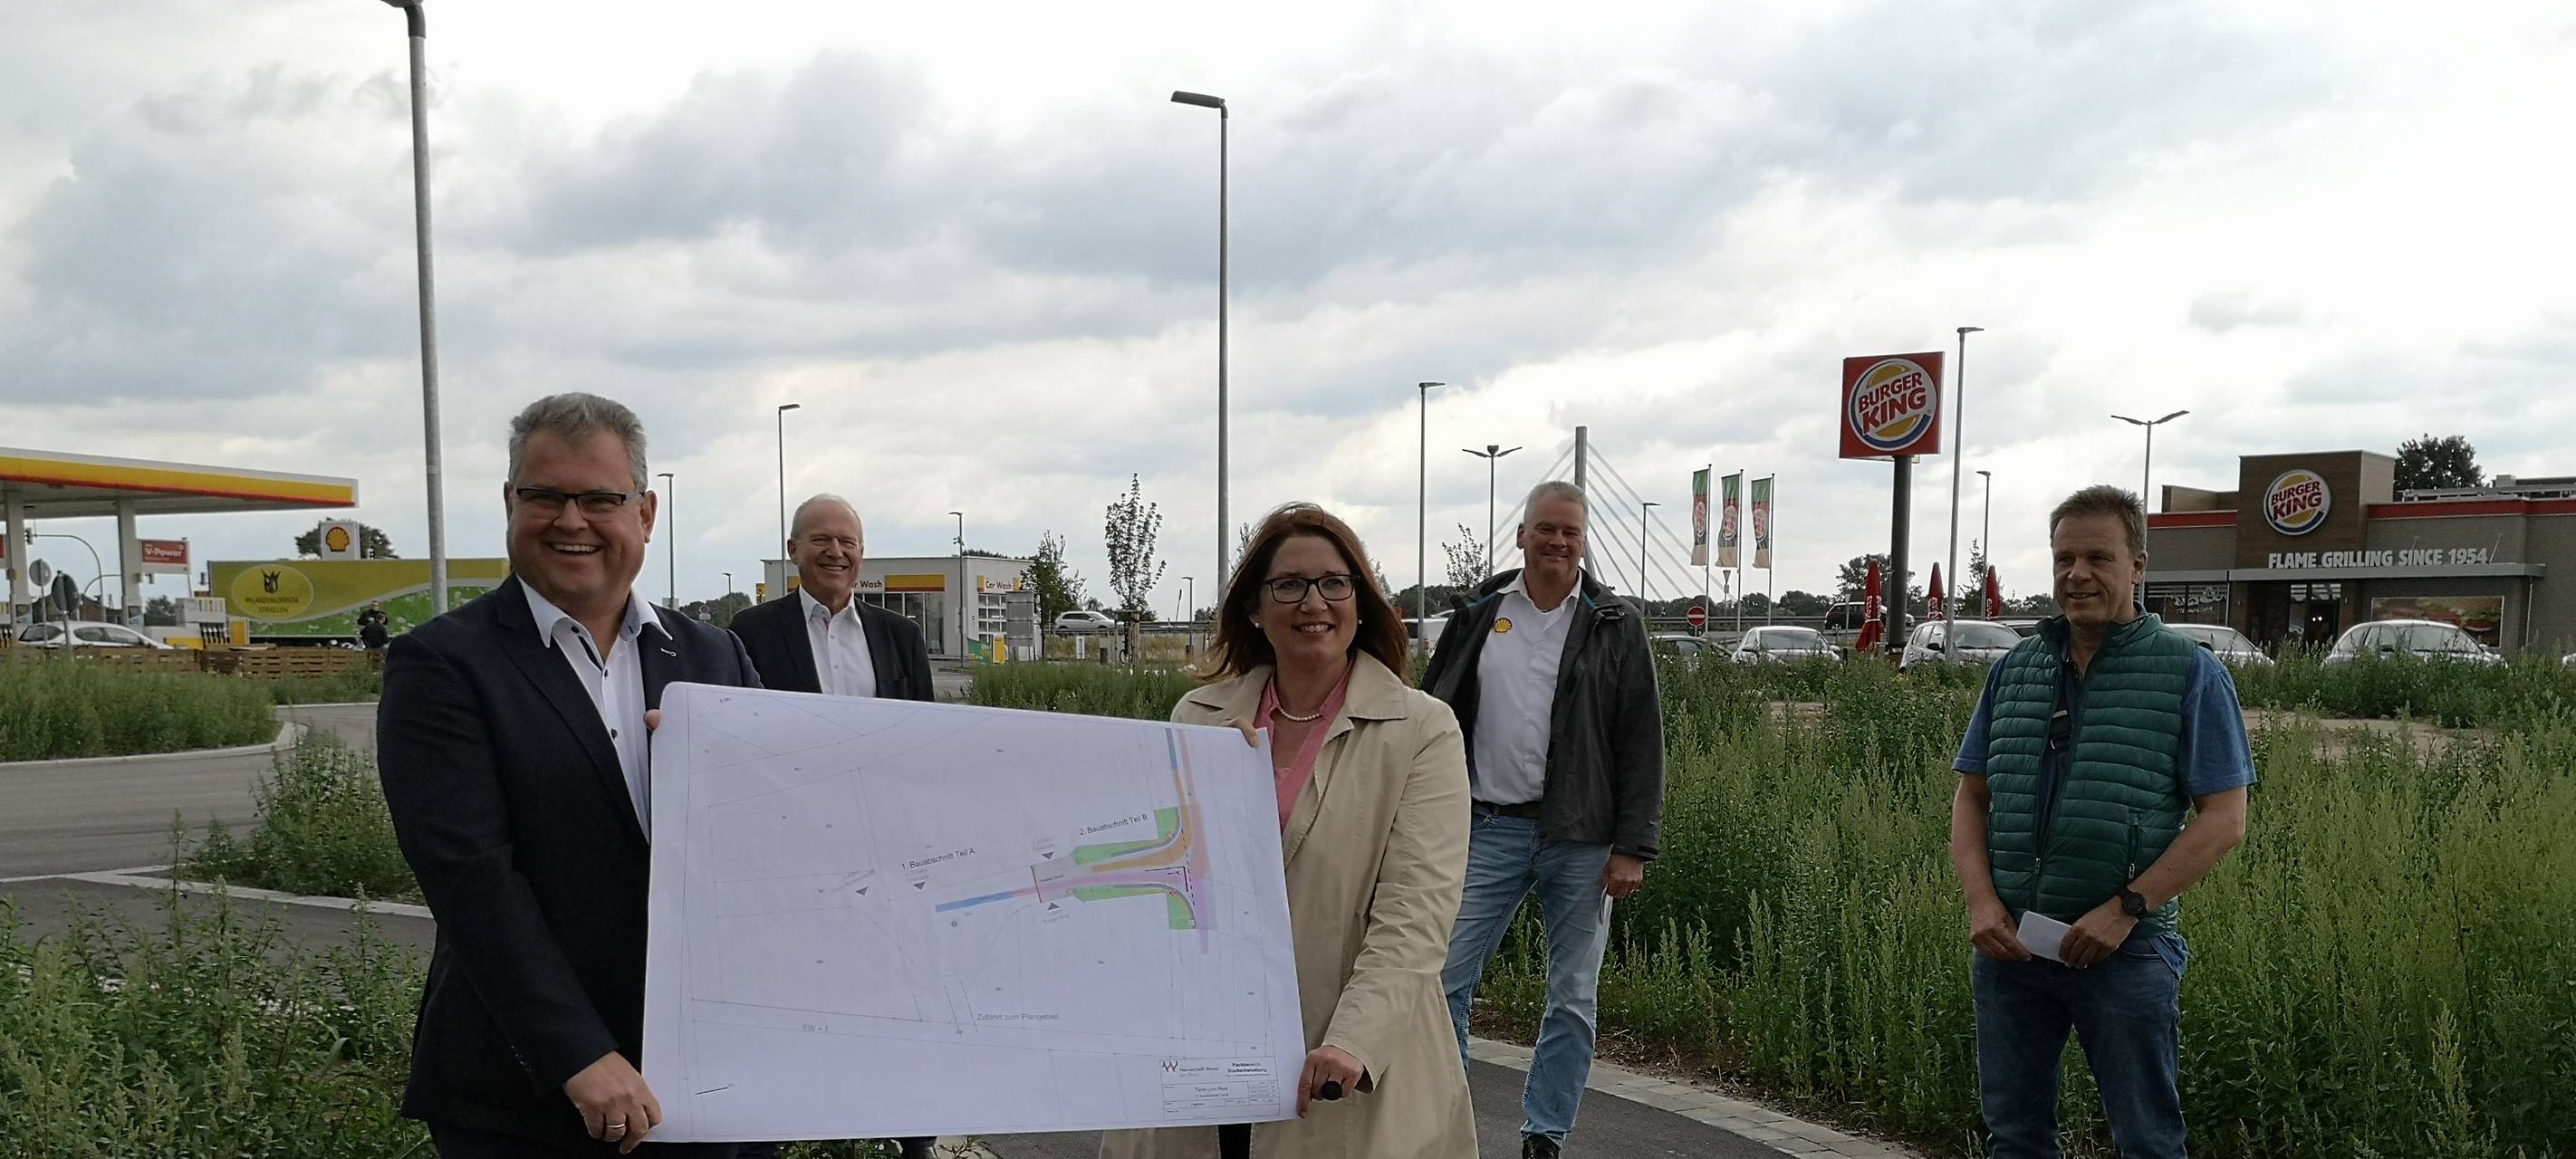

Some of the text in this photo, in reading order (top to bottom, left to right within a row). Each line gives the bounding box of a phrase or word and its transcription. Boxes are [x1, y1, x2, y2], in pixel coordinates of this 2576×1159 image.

[1858, 371, 1923, 413] BURGER
[1862, 387, 1927, 435] KING
[2271, 481, 2321, 506] BURGER
[2273, 492, 2322, 522] KING
[145, 547, 183, 557] V-Power
[2268, 548, 2486, 569] FLAME GRILLING SINCE 1954
[860, 580, 883, 589] Wash
[985, 580, 1013, 590] Car Wash
[908, 852, 955, 869] Bauabschnitt
[956, 849, 968, 857] Teil
